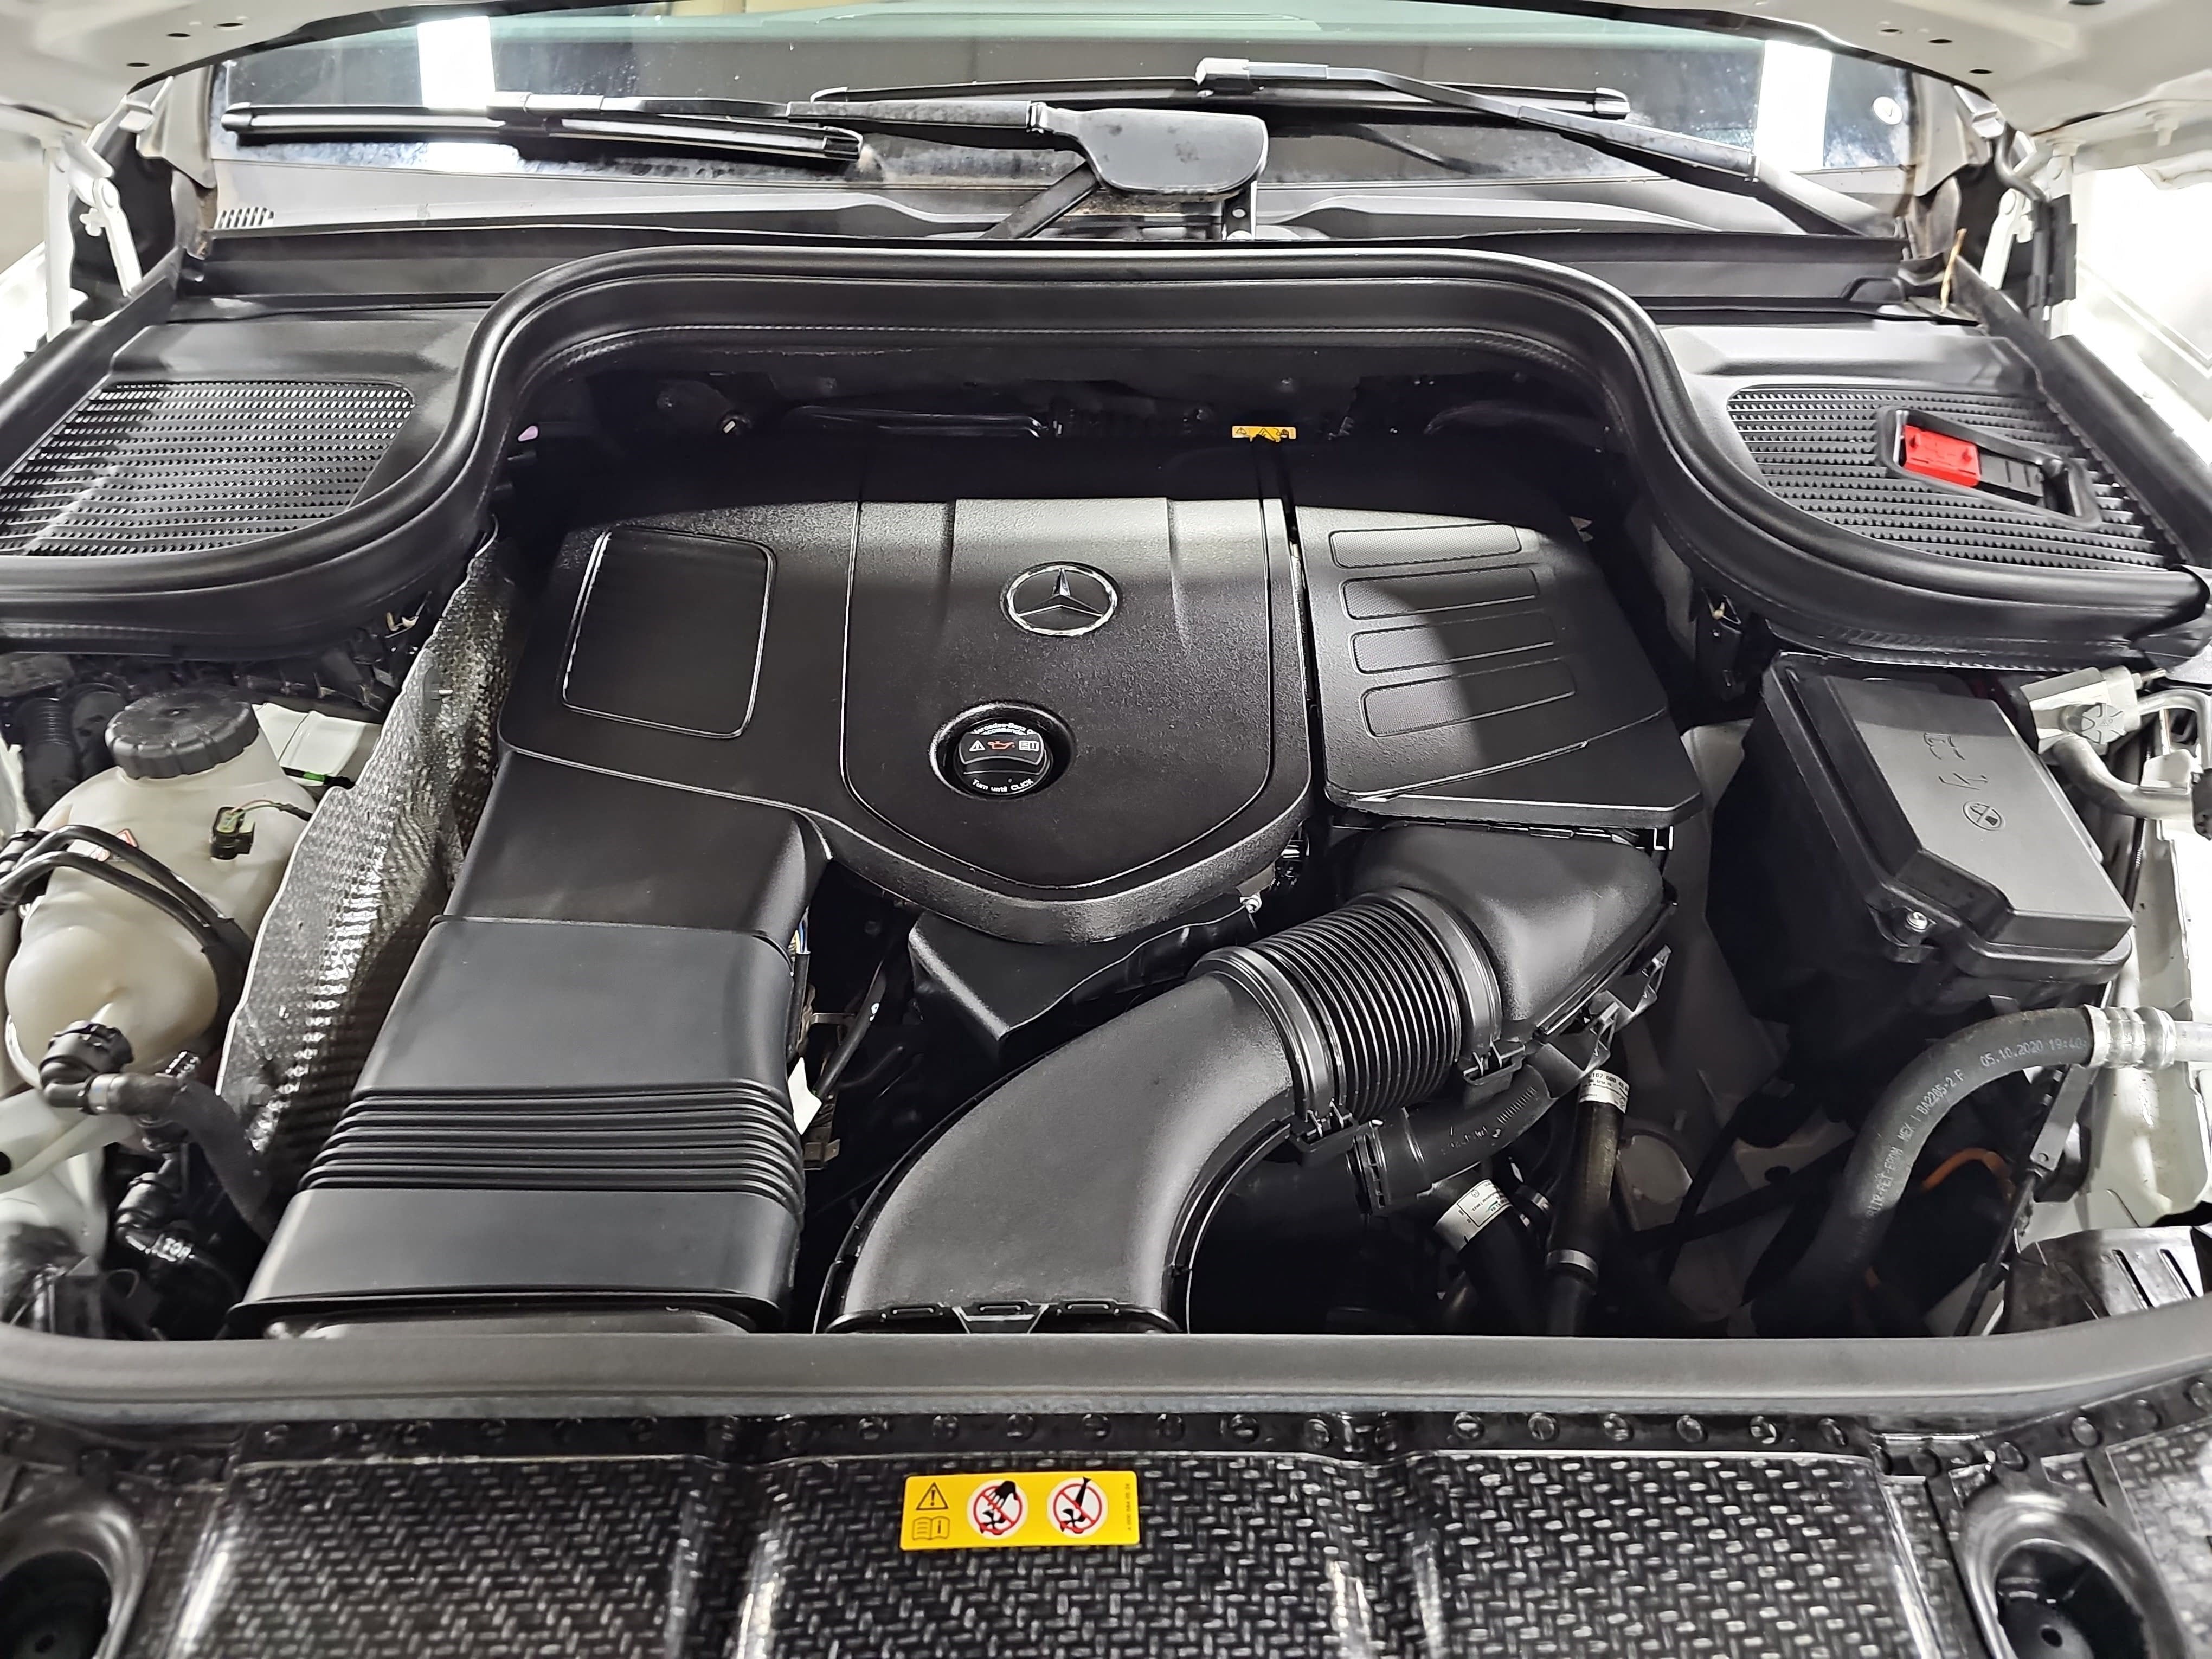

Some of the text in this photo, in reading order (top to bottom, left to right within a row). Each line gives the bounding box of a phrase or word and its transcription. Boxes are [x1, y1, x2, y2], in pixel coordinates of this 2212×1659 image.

[973, 779, 988, 790] Turn
[1011, 778, 1034, 790] CLICK
[1980, 1040, 2043, 1067] 05.10.2020
